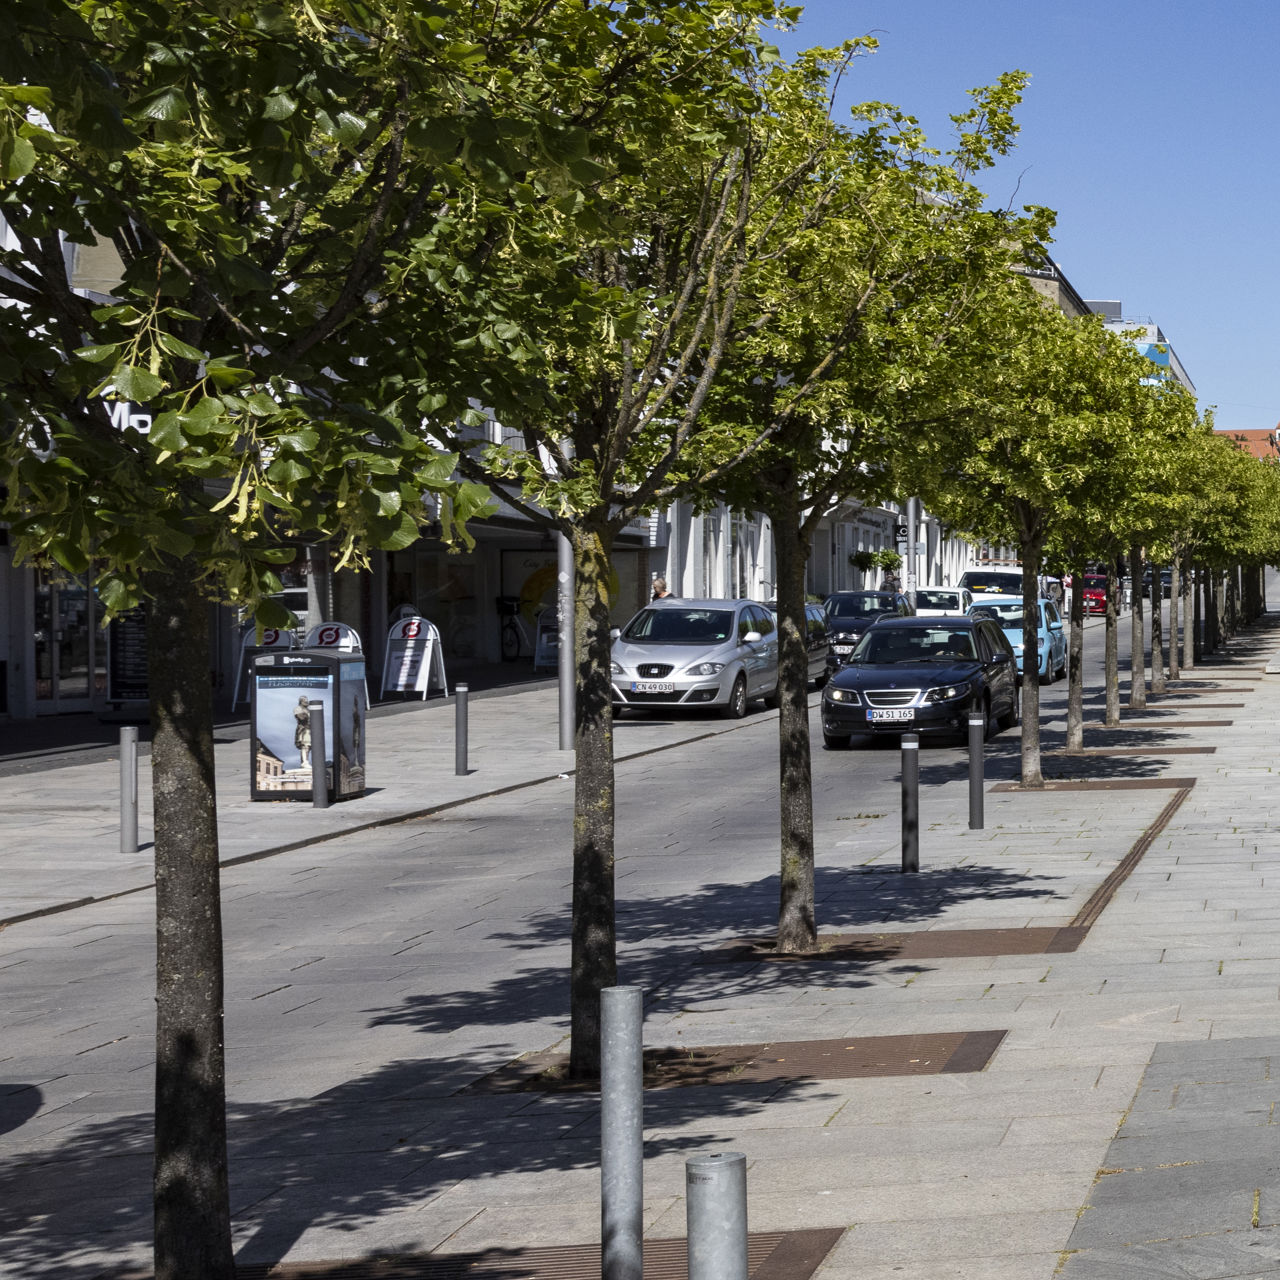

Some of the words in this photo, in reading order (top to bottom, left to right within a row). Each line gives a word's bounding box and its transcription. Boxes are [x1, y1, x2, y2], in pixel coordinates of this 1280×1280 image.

[636, 683, 647, 691] CN
[648, 683, 657, 691] 49
[658, 683, 673, 691] 030
[873, 711, 885, 719] DW
[898, 710, 913, 718] 165
